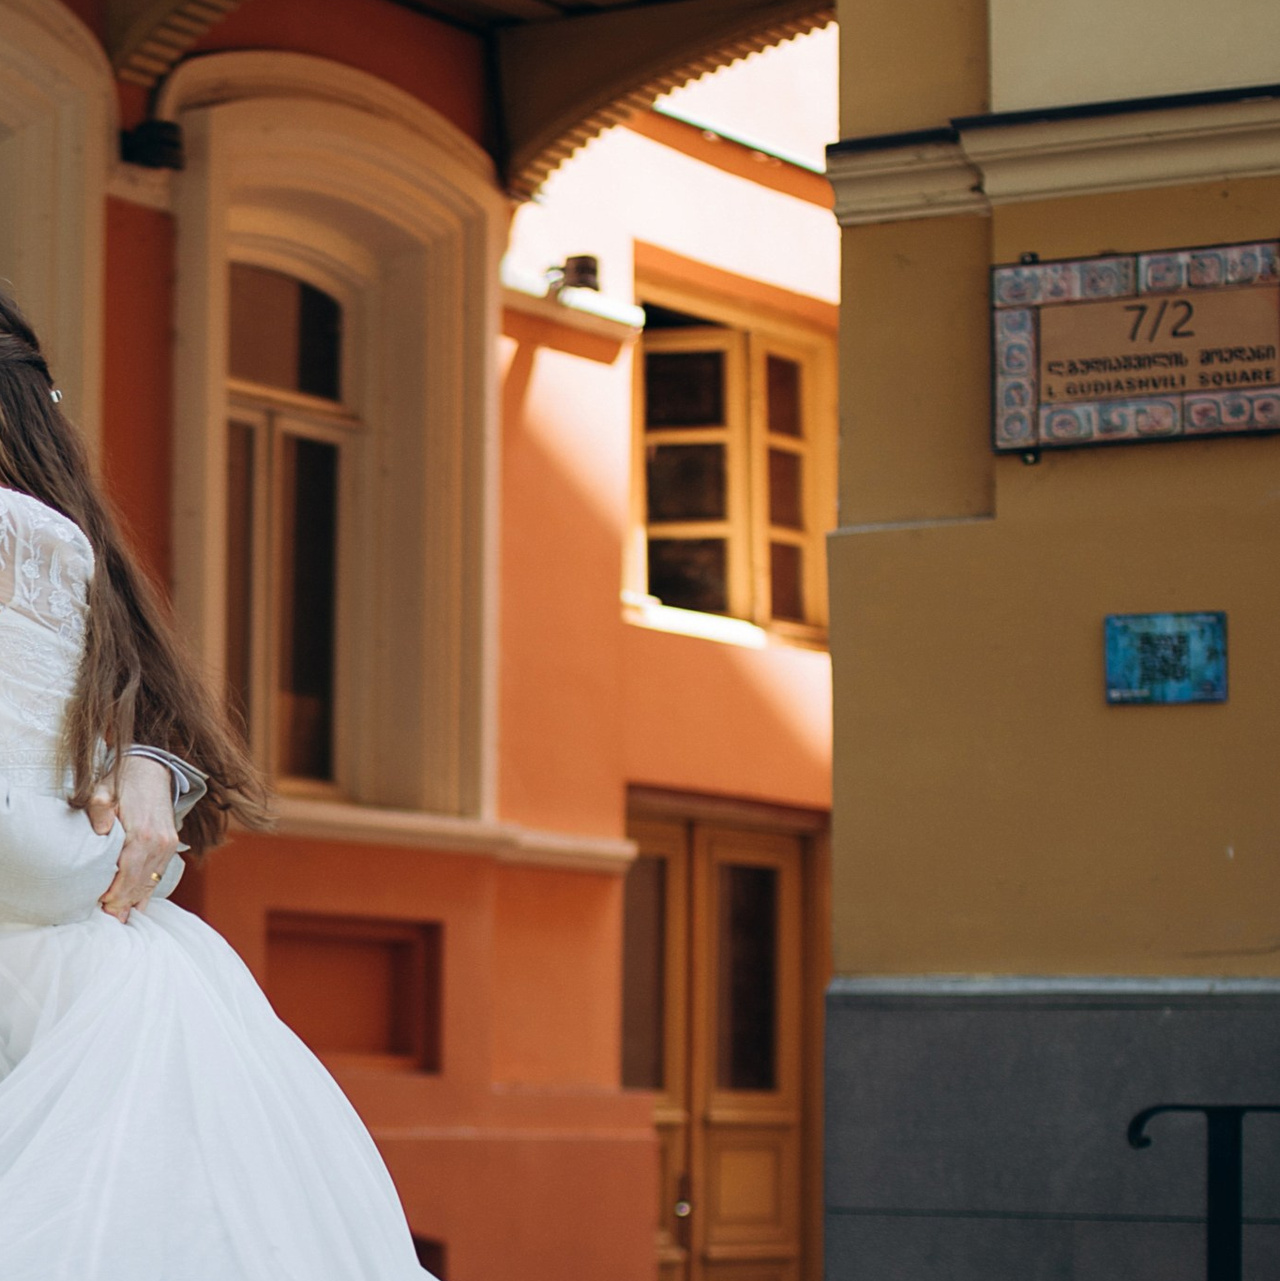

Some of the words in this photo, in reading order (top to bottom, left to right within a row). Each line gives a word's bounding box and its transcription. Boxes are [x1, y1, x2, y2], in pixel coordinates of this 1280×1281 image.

[1124, 299, 1194, 341] 7/2
[1065, 373, 1185, 395] GUDIASHVILI
[1198, 367, 1274, 386] SQUARE
